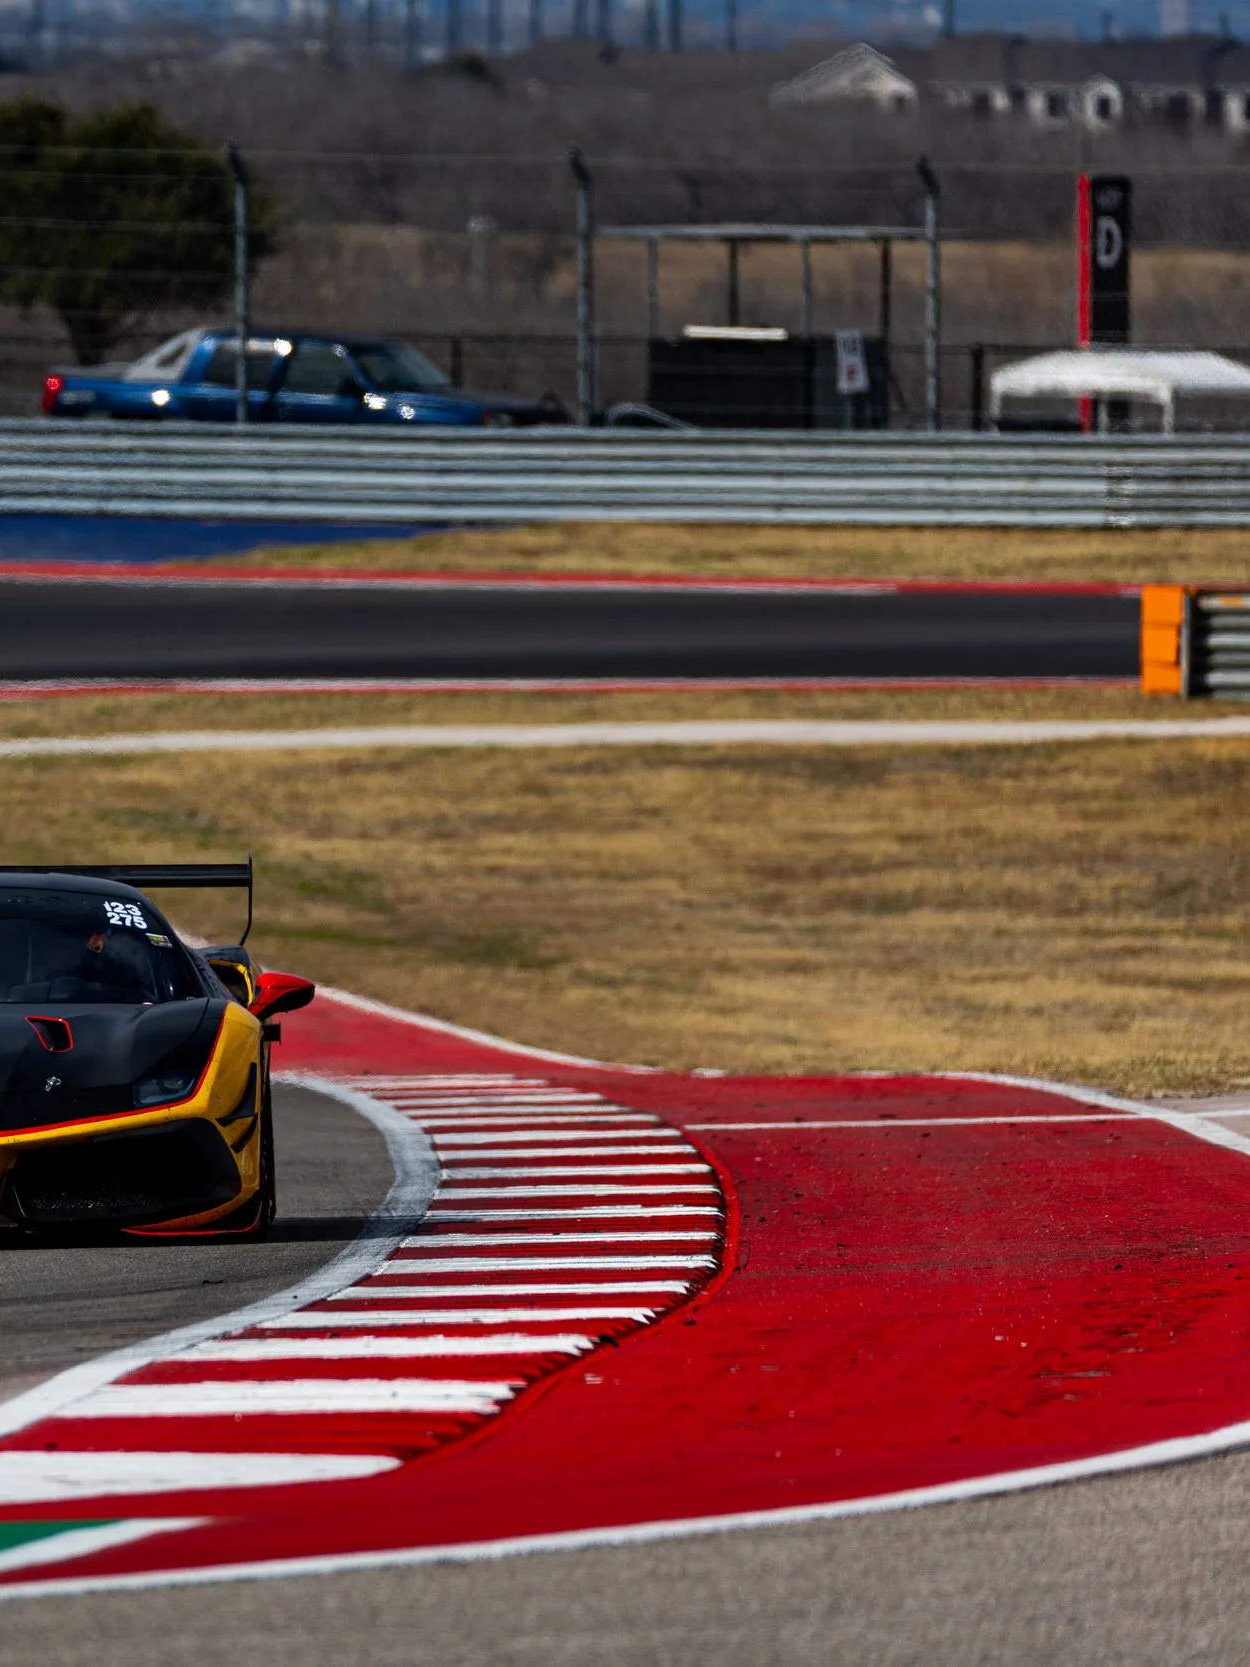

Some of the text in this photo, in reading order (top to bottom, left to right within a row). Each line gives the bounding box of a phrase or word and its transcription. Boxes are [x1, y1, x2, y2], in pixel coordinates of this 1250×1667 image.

[1097, 215, 1122, 269] D
[102, 901, 142, 916] 123
[107, 911, 148, 930] 275
